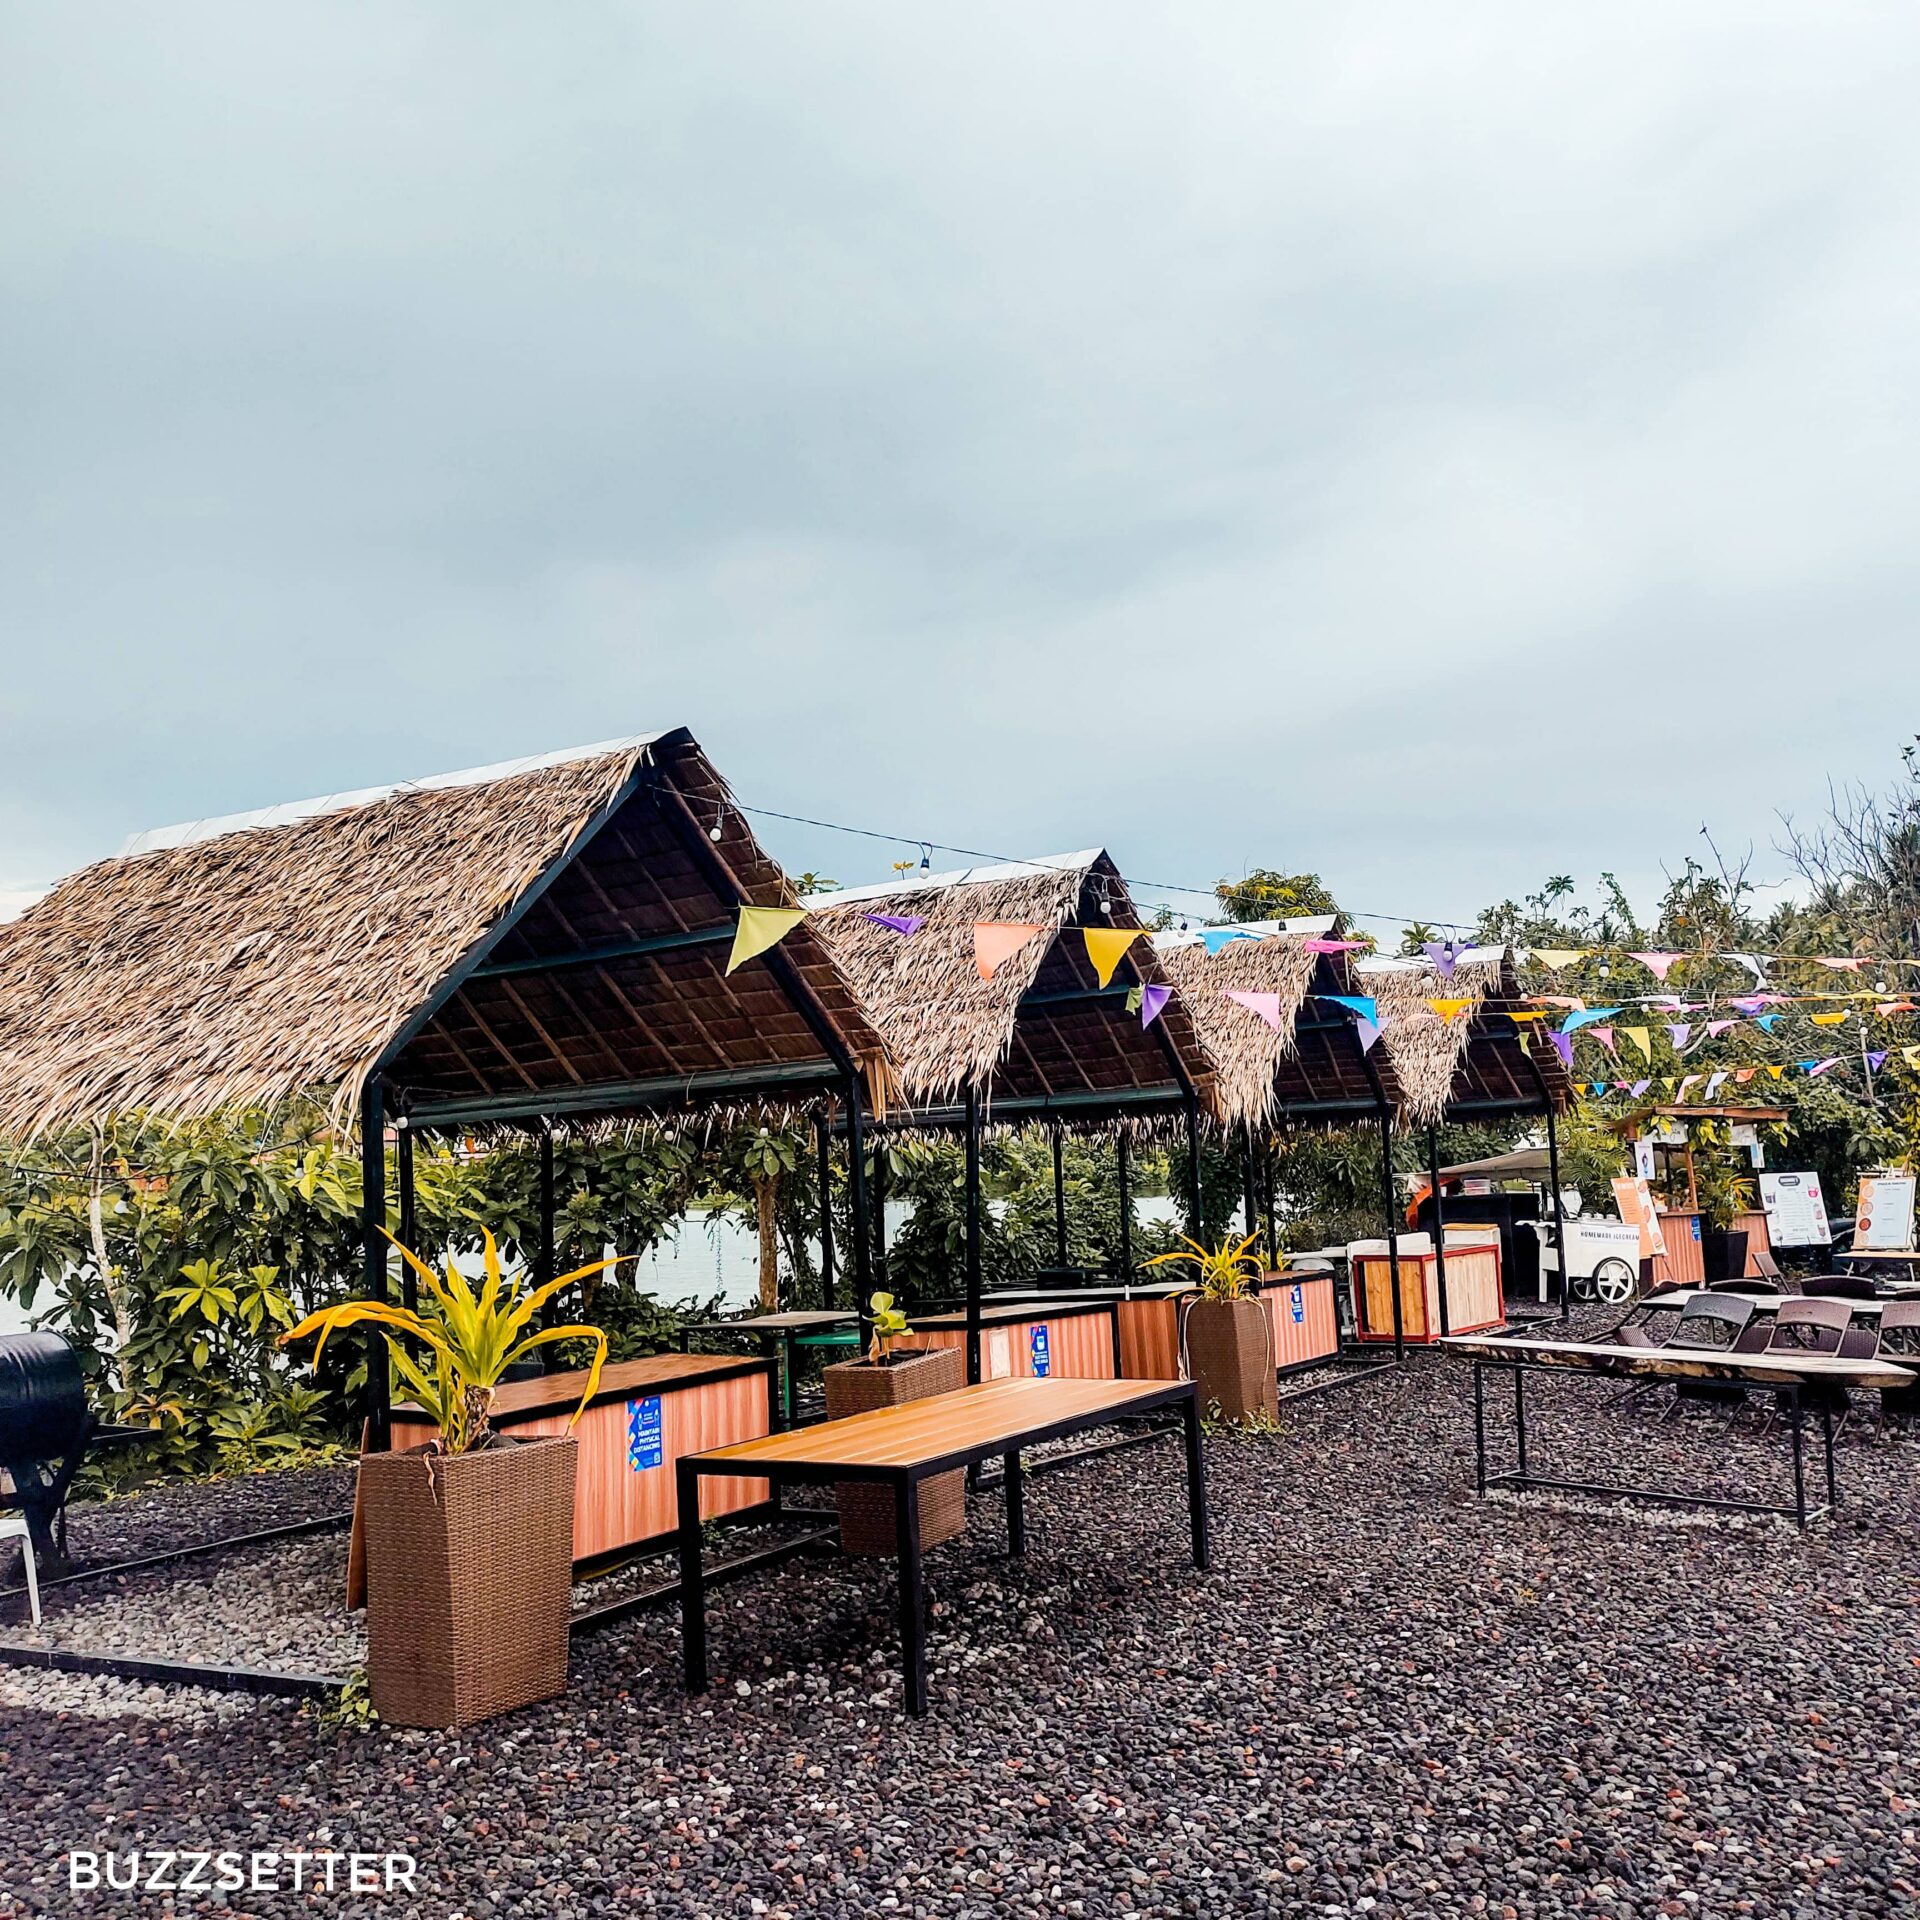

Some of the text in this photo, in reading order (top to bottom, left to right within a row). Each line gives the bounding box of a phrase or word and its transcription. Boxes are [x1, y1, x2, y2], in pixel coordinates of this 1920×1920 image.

[638, 1427, 660, 1438] MAINTAIN
[639, 1434, 660, 1445] PHYSICAL
[633, 1442, 661, 1453] DISTANCING
